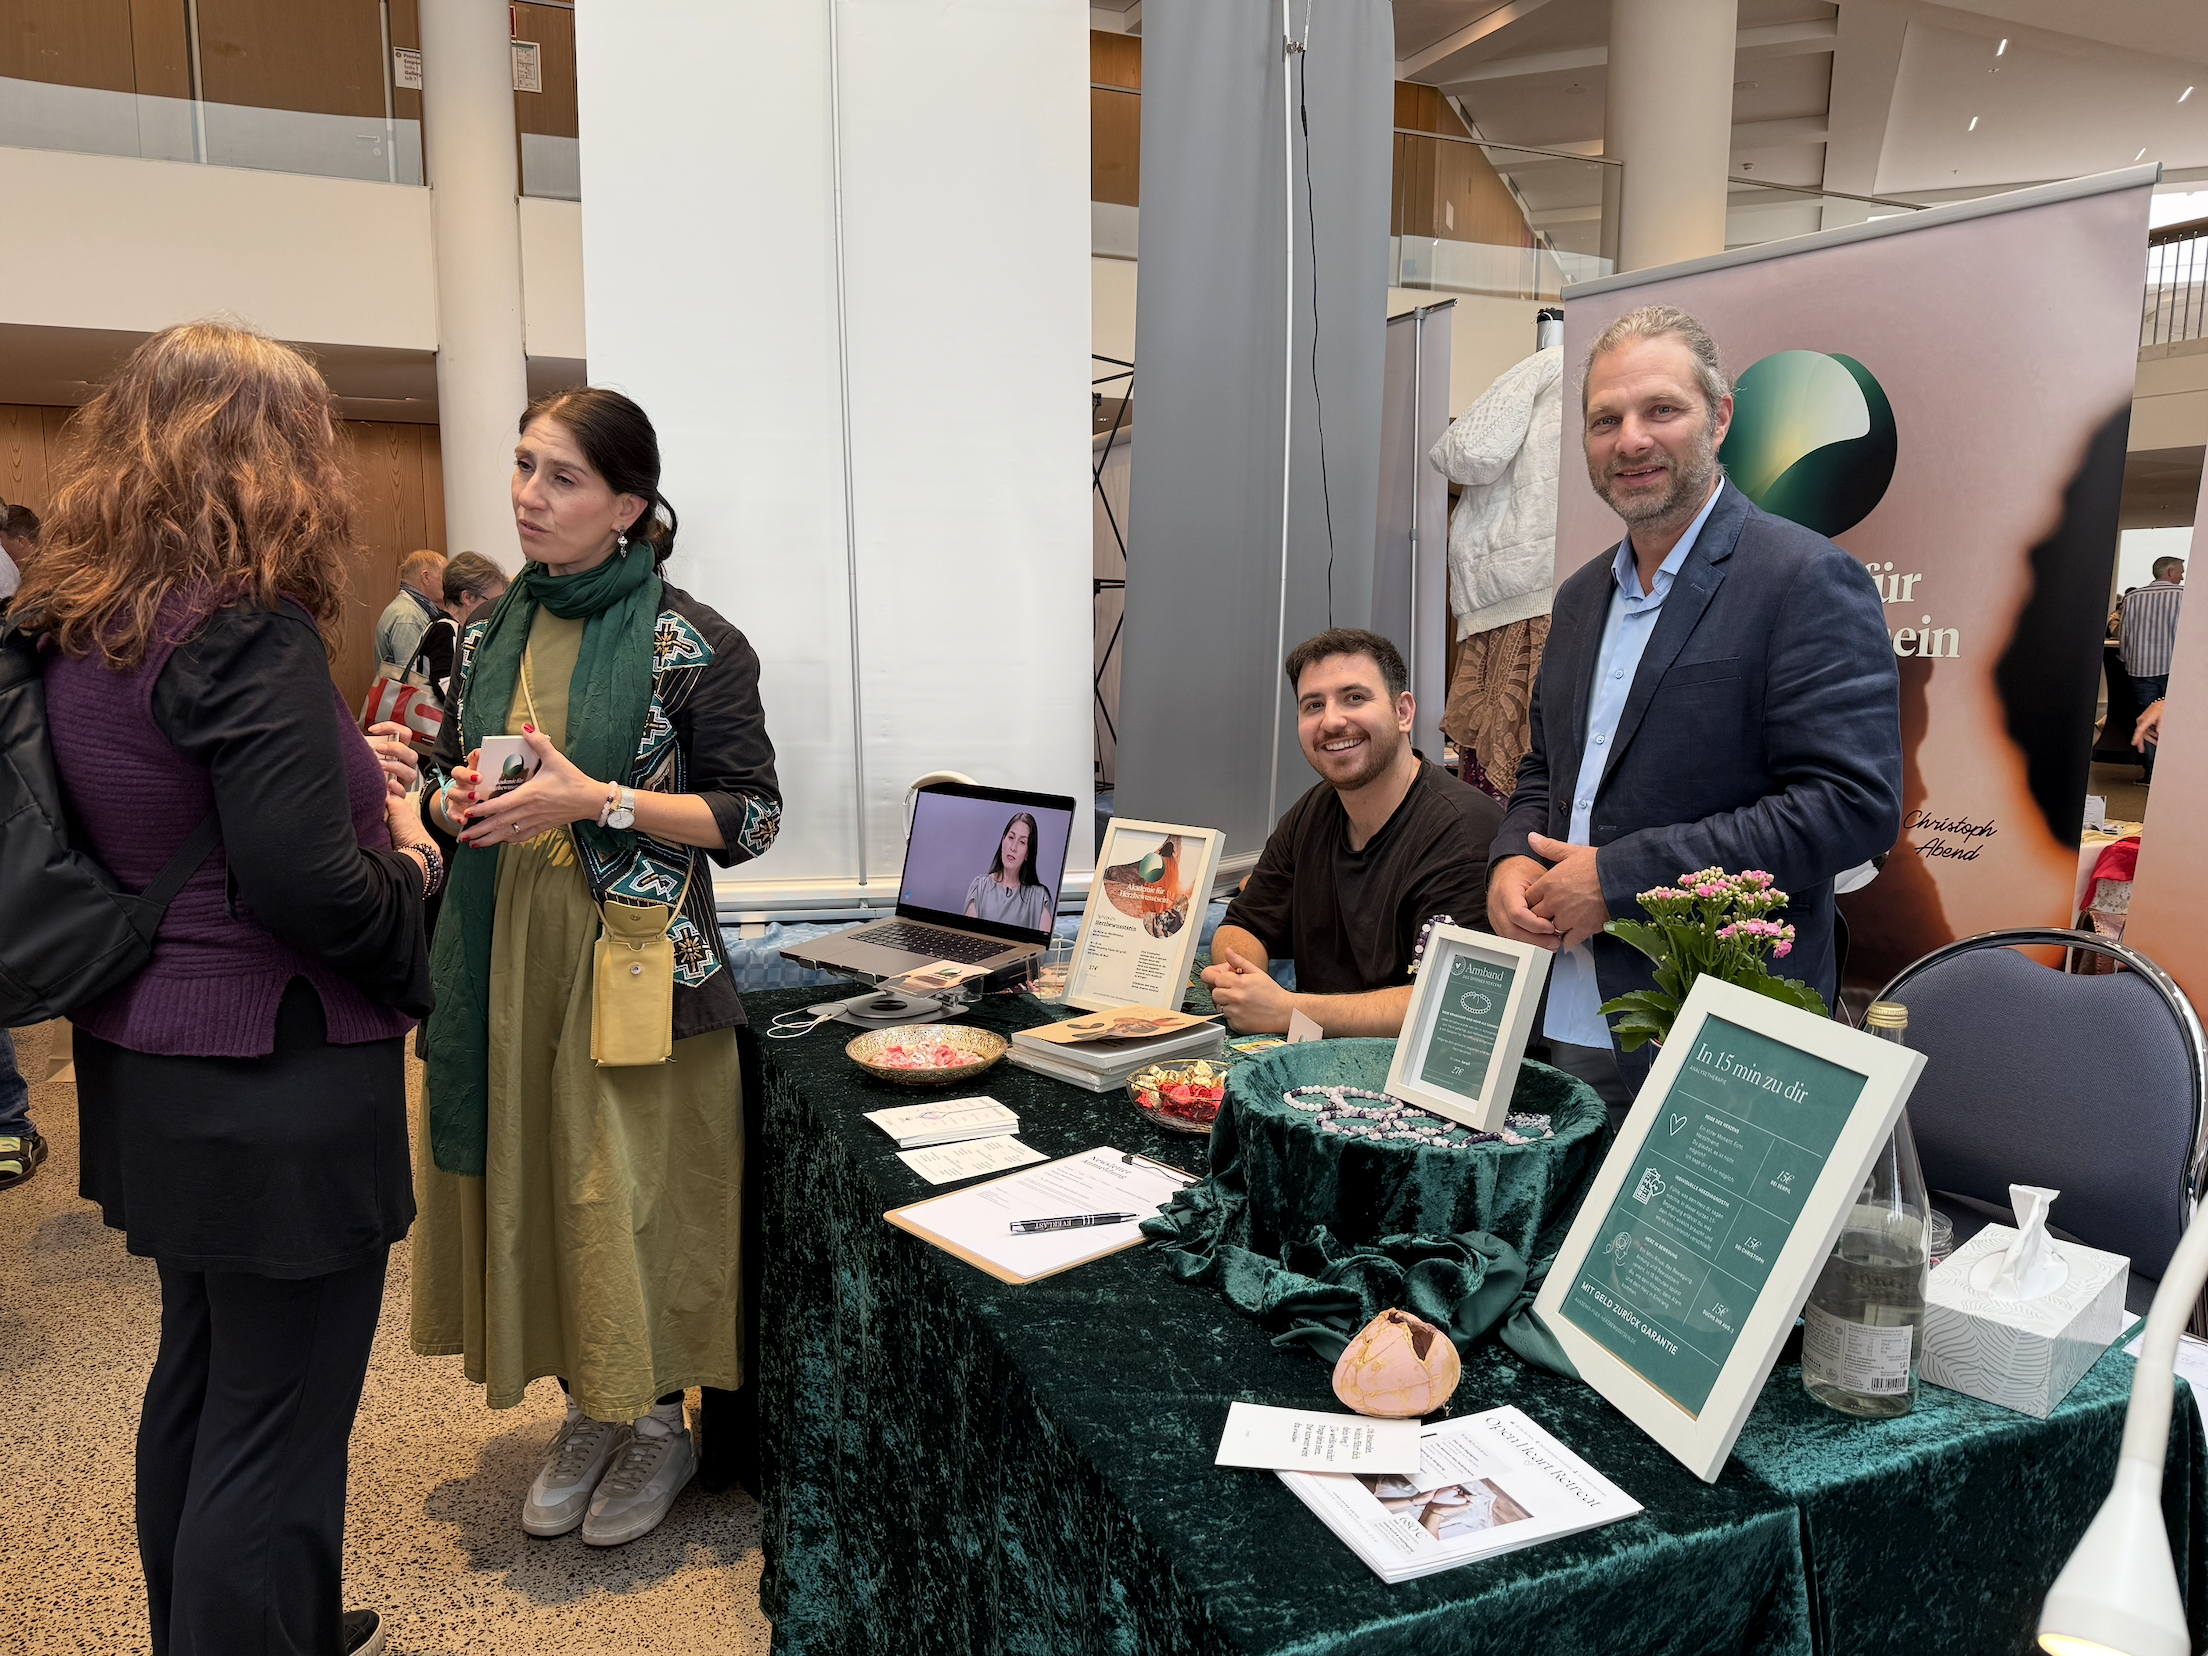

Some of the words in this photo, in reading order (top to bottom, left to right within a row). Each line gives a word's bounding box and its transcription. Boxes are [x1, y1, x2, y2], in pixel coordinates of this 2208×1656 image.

[1865, 561, 1923, 604] für
[1889, 614, 1961, 659] ein
[1903, 809, 1998, 839] Christoph
[1914, 838, 1984, 862] Abend
[1696, 1042, 1712, 1064] In
[1714, 1051, 1734, 1071] 15
[1732, 1063, 1761, 1084] min
[1762, 1075, 1782, 1093] zu
[1784, 1081, 1808, 1103] dir
[1776, 1170, 1794, 1183] 15€
[1744, 1236, 1761, 1249] 15€
[1580, 1281, 1595, 1294] MIT
[1594, 1290, 1612, 1307] GELD
[1612, 1303, 1640, 1328] ZURÜCK
[1640, 1324, 1677, 1354] GARANTIE
[1711, 1302, 1728, 1316] 15€
[1485, 1417, 1518, 1442] Open
[1516, 1442, 1553, 1469] Heart
[1550, 1470, 1599, 1506] Retreat
